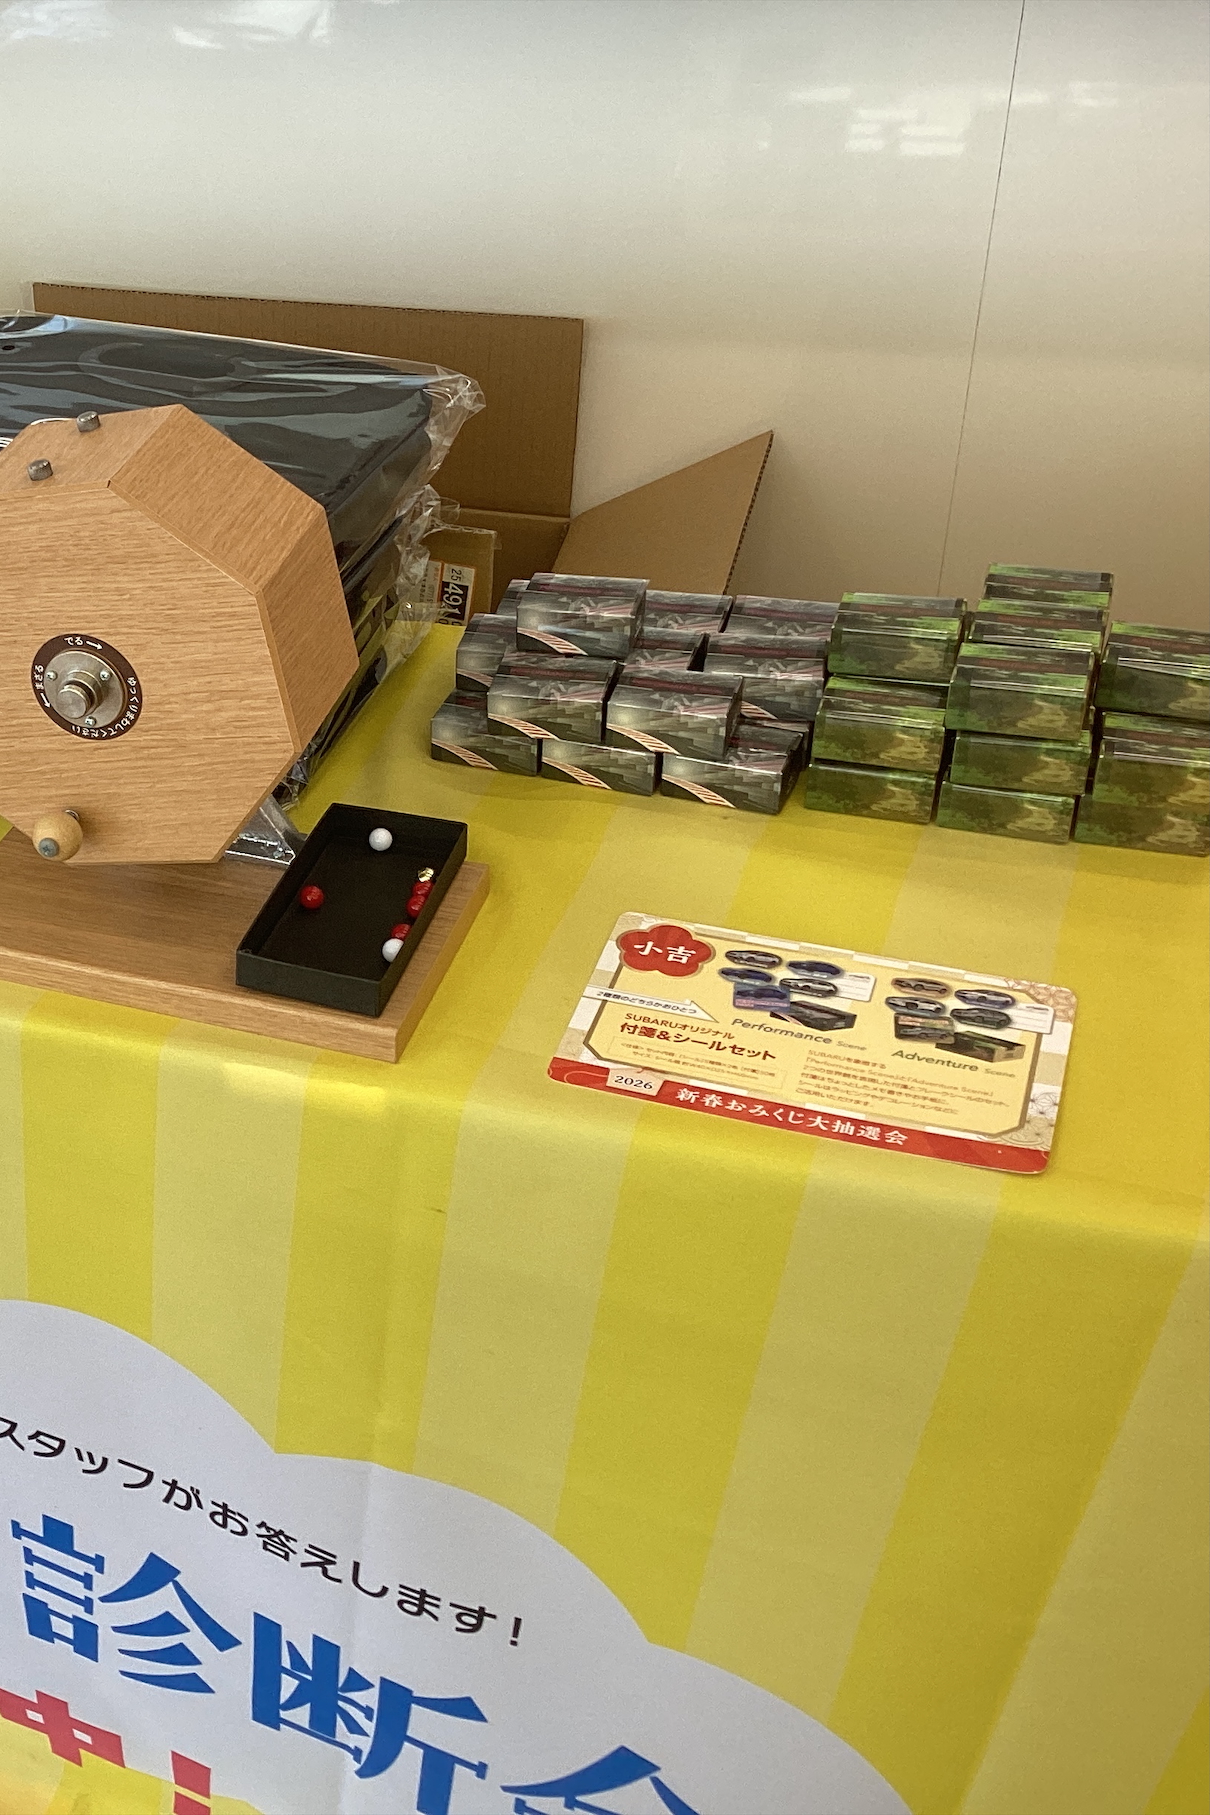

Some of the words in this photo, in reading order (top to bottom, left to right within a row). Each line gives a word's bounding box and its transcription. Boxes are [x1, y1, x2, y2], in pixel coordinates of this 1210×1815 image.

[64, 636, 84, 646] でる
[72, 677, 140, 737] ゆっくりまわしてください
[633, 941, 697, 965] 小吉
[624, 1012, 736, 1040] SUBARUオリジナル
[732, 1018, 833, 1045] Performance
[836, 1040, 867, 1052] Scene
[891, 1049, 979, 1073] Adventure
[984, 1068, 1016, 1079] Scene
[614, 1075, 653, 1090] 2026
[675, 1087, 908, 1146] 新春おみくじ大抽選会
